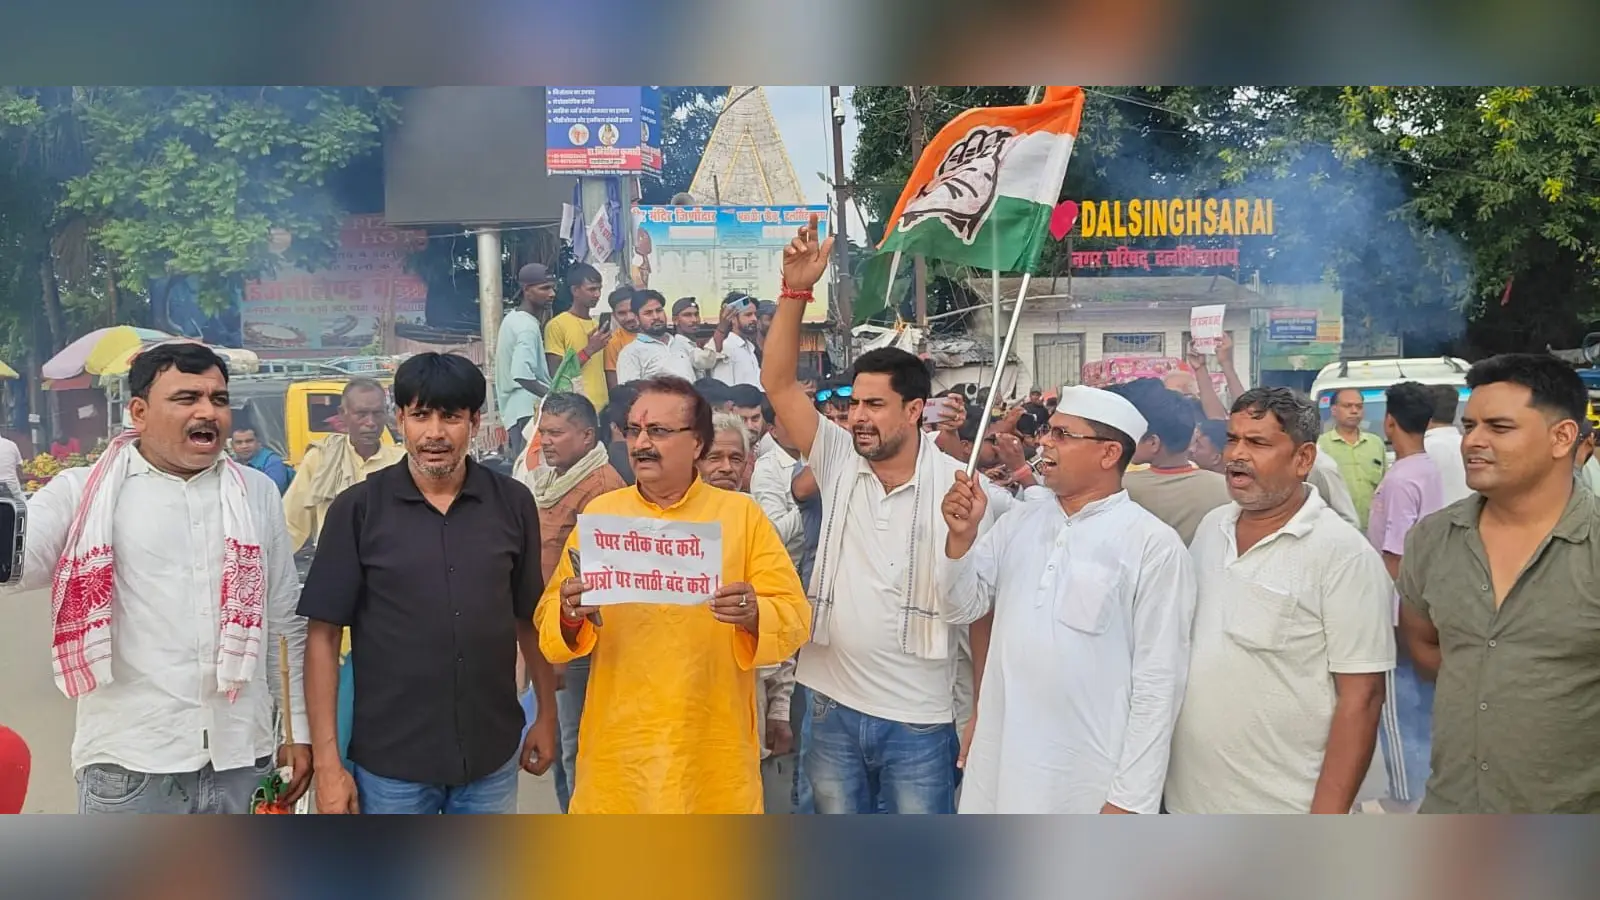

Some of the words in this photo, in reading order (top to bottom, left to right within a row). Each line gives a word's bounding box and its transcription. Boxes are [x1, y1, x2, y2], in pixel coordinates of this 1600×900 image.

[1081, 198, 1273, 238] DALSINGHSARAI
[1072, 250, 1103, 268] नगर
[1107, 246, 1151, 271] परिषद्
[594, 529, 620, 551] पेपर
[623, 530, 652, 552] लीक
[654, 534, 673, 556] बंद
[675, 534, 705, 559] करो,
[615, 570, 631, 588] पर
[633, 569, 663, 591] लाठी
[665, 570, 684, 593] बंद
[685, 572, 710, 595] करो
